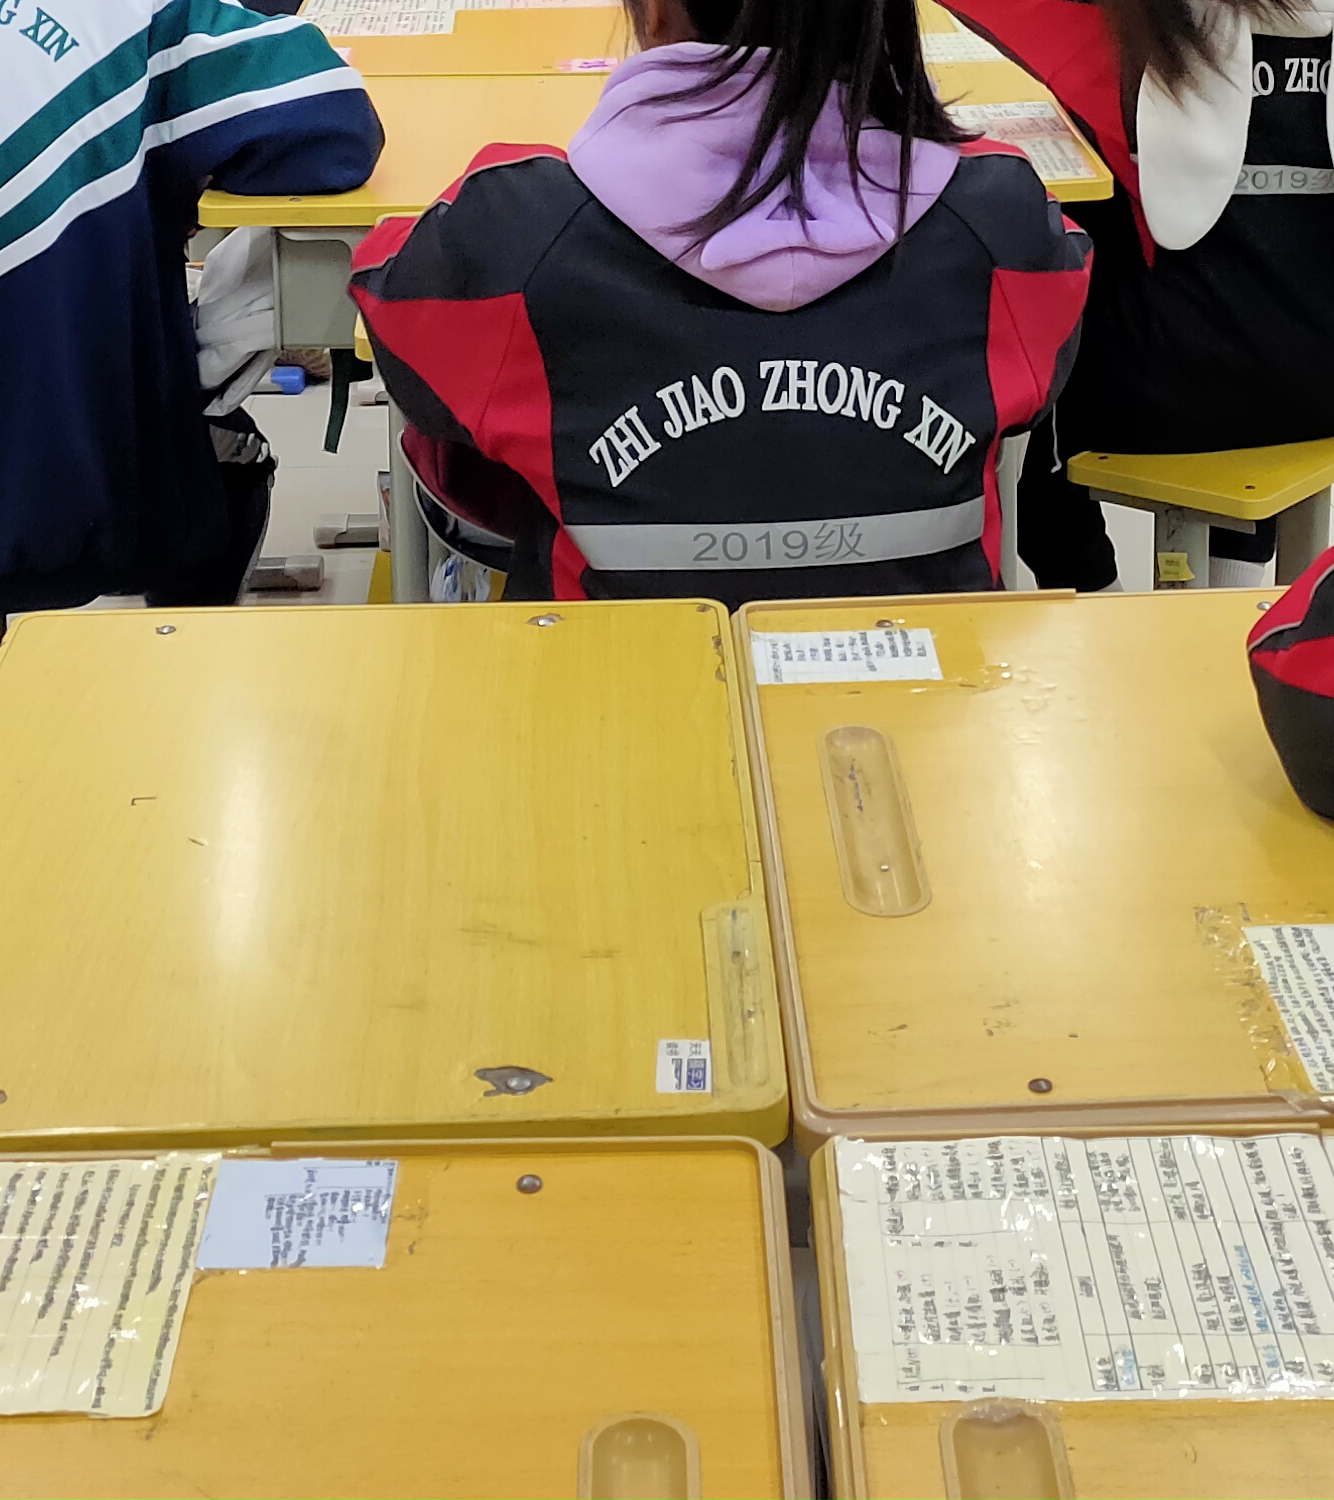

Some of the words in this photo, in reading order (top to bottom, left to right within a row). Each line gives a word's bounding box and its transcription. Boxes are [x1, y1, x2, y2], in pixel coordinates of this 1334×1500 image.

[20, 7, 79, 63] XIN
[588, 405, 661, 488] ZHI
[656, 366, 746, 439] JIAO
[759, 360, 905, 430] ZHONG
[903, 395, 976, 475] XIN
[692, 522, 868, 562] 2019级
